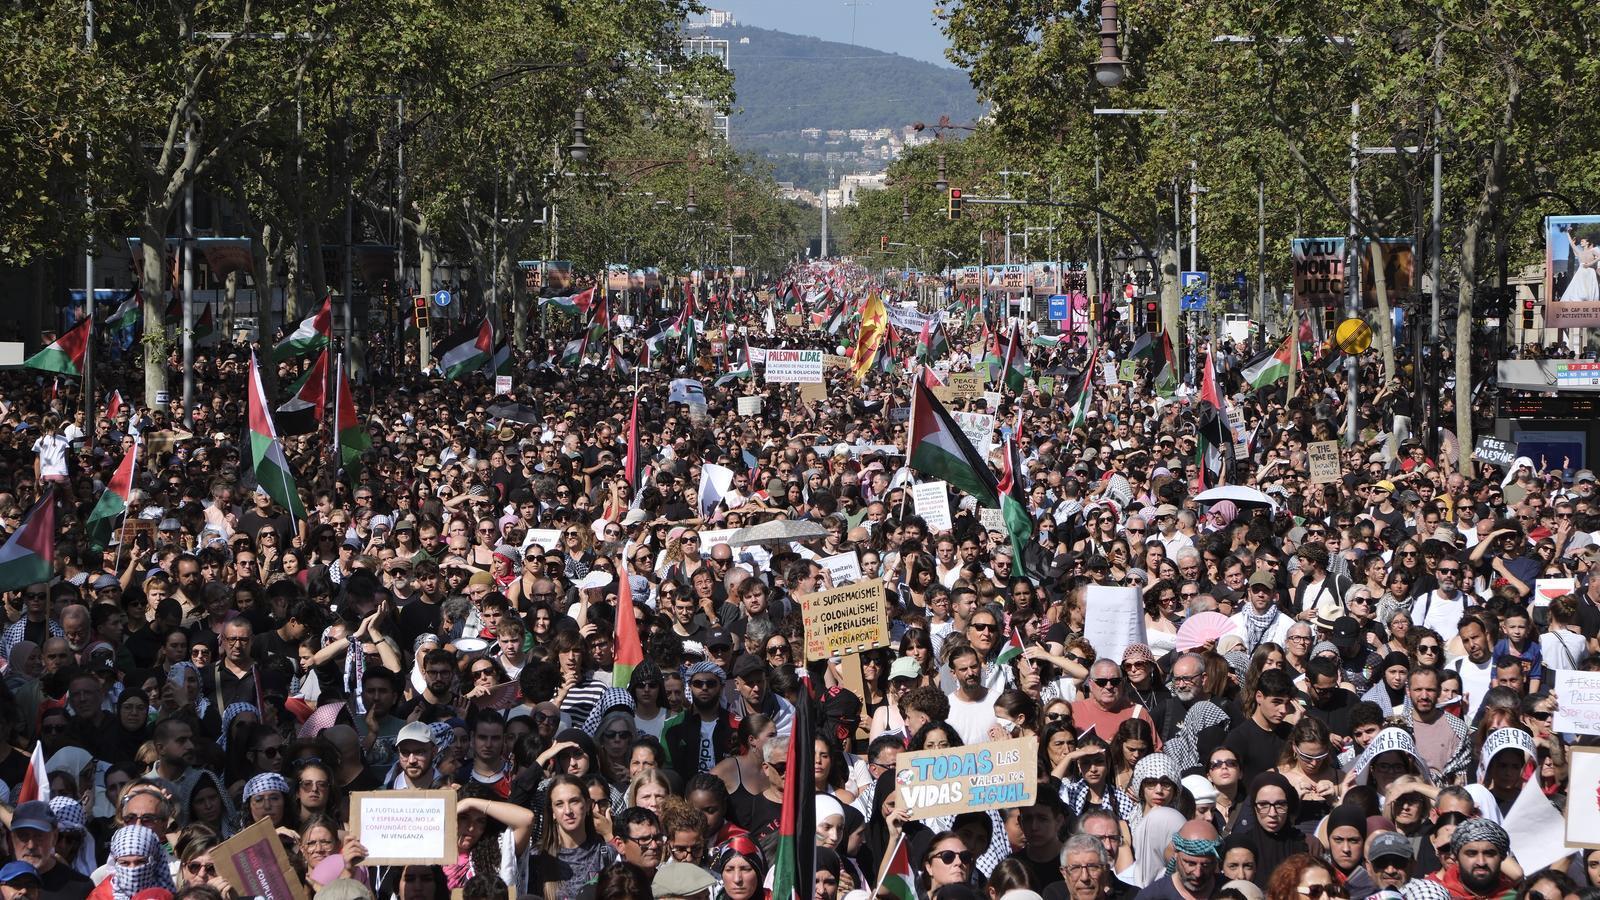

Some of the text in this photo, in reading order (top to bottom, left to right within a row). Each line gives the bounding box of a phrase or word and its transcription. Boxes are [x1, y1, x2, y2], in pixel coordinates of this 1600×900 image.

[1300, 241, 1336, 256] VIU
[1296, 260, 1341, 275] MONT
[768, 352, 799, 361] PALESTINA
[800, 352, 820, 361] LIBRE
[1316, 445, 1331, 453] THE
[1483, 439, 1505, 450] FREE
[1476, 447, 1514, 463] PALESTINE
[832, 564, 853, 573] sanitaris
[911, 749, 1020, 781] TODAS LAS
[970, 772, 1024, 786] VALEN POR
[901, 782, 963, 808] VIDAS
